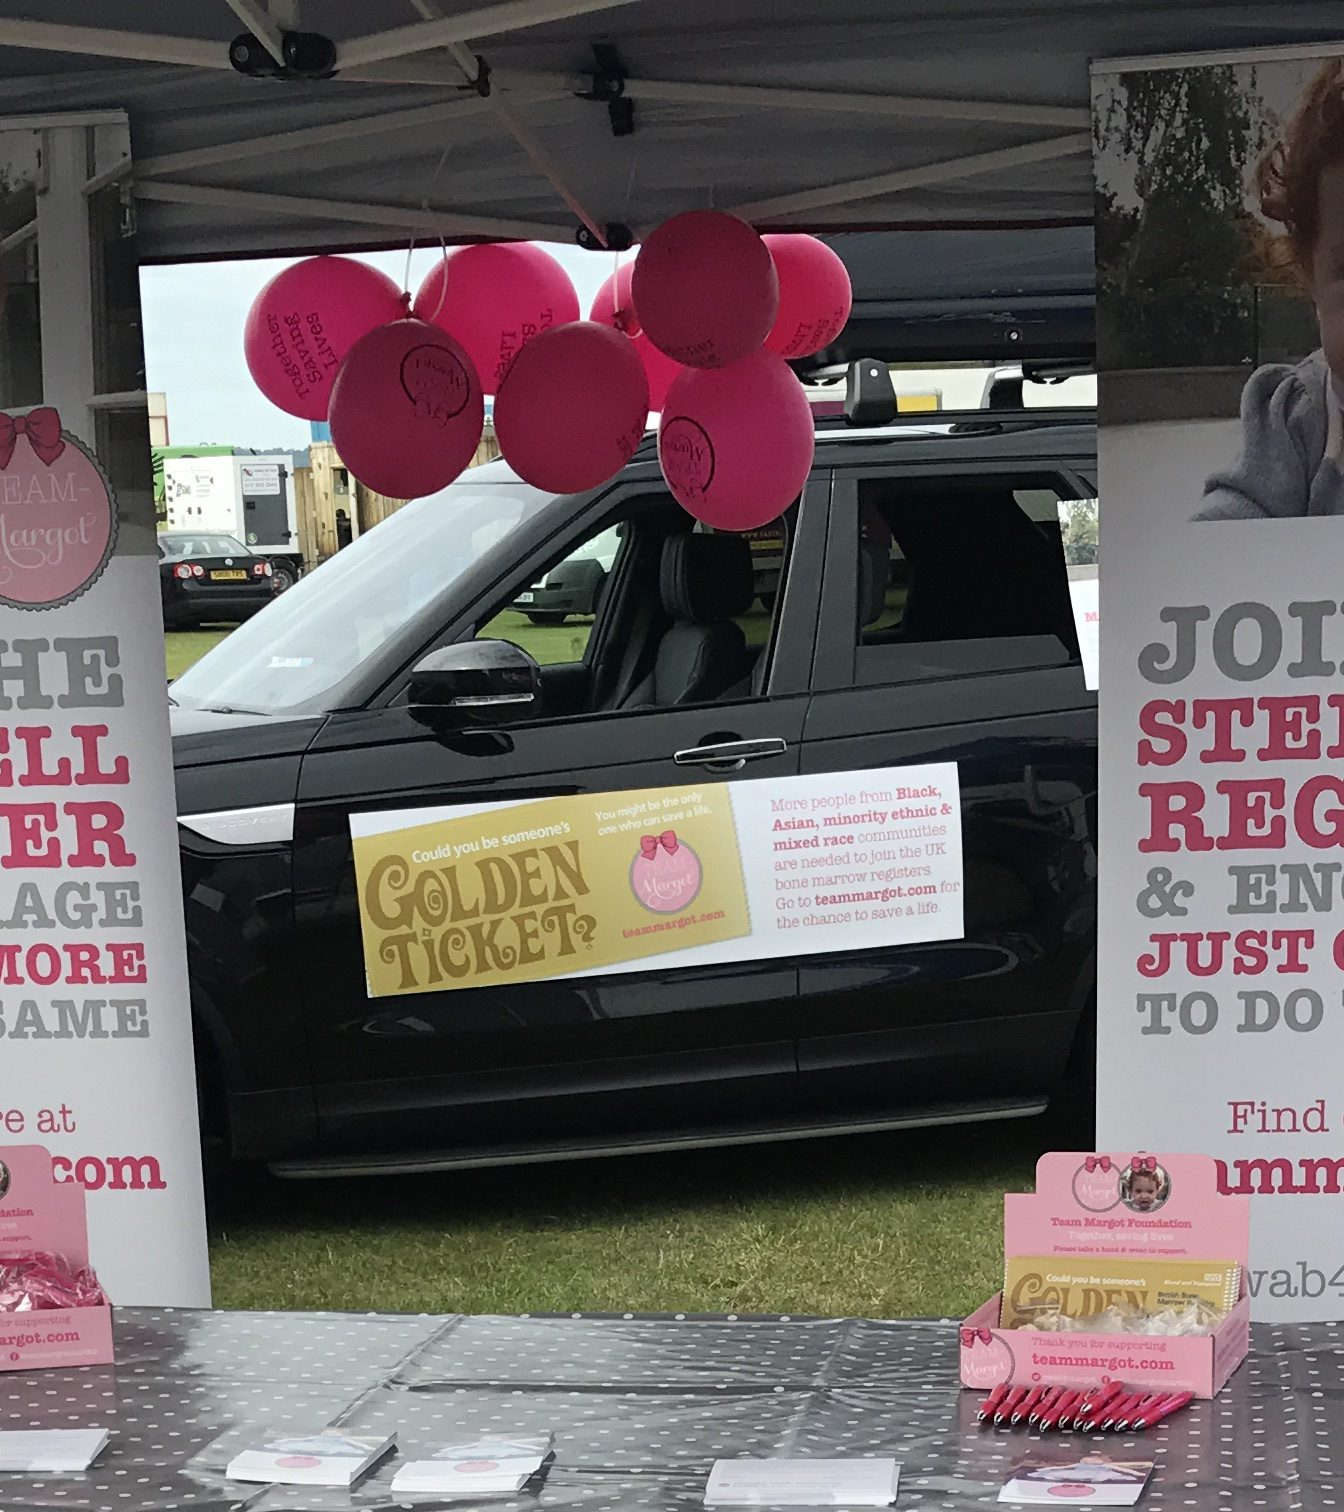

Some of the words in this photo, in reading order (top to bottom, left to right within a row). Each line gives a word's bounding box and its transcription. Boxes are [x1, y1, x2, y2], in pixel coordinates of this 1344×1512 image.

[771, 799, 808, 812] More
[811, 794, 856, 811] people
[859, 790, 892, 803] from
[896, 785, 942, 800] Black,
[772, 818, 820, 832] Asian,
[823, 810, 888, 827] minority
[891, 805, 937, 820] ethnic
[940, 803, 952, 815] &
[412, 844, 451, 864] Could
[453, 841, 480, 858] you
[482, 836, 499, 850] be
[501, 821, 570, 846] someone's
[773, 836, 819, 852] mixed
[823, 833, 855, 847] race
[857, 824, 947, 843] communities
[363, 840, 592, 932] GOLDEN
[775, 897, 795, 910] Go
[797, 896, 812, 907] to
[815, 883, 937, 906] teammargot.com
[939, 880, 961, 893] for
[1136, 866, 1194, 919] &
[1136, 929, 1315, 979] JUST
[1136, 992, 1219, 1036] TO
[1236, 989, 1324, 1033] DO
[37, 1104, 76, 1134] at
[1227, 1100, 1329, 1133] Find
[1051, 1217, 1081, 1227] Team
[1085, 1218, 1124, 1230] Margot
[1128, 1218, 1192, 1229] Foundation
[1032, 1353, 1175, 1370] teammargot.com
